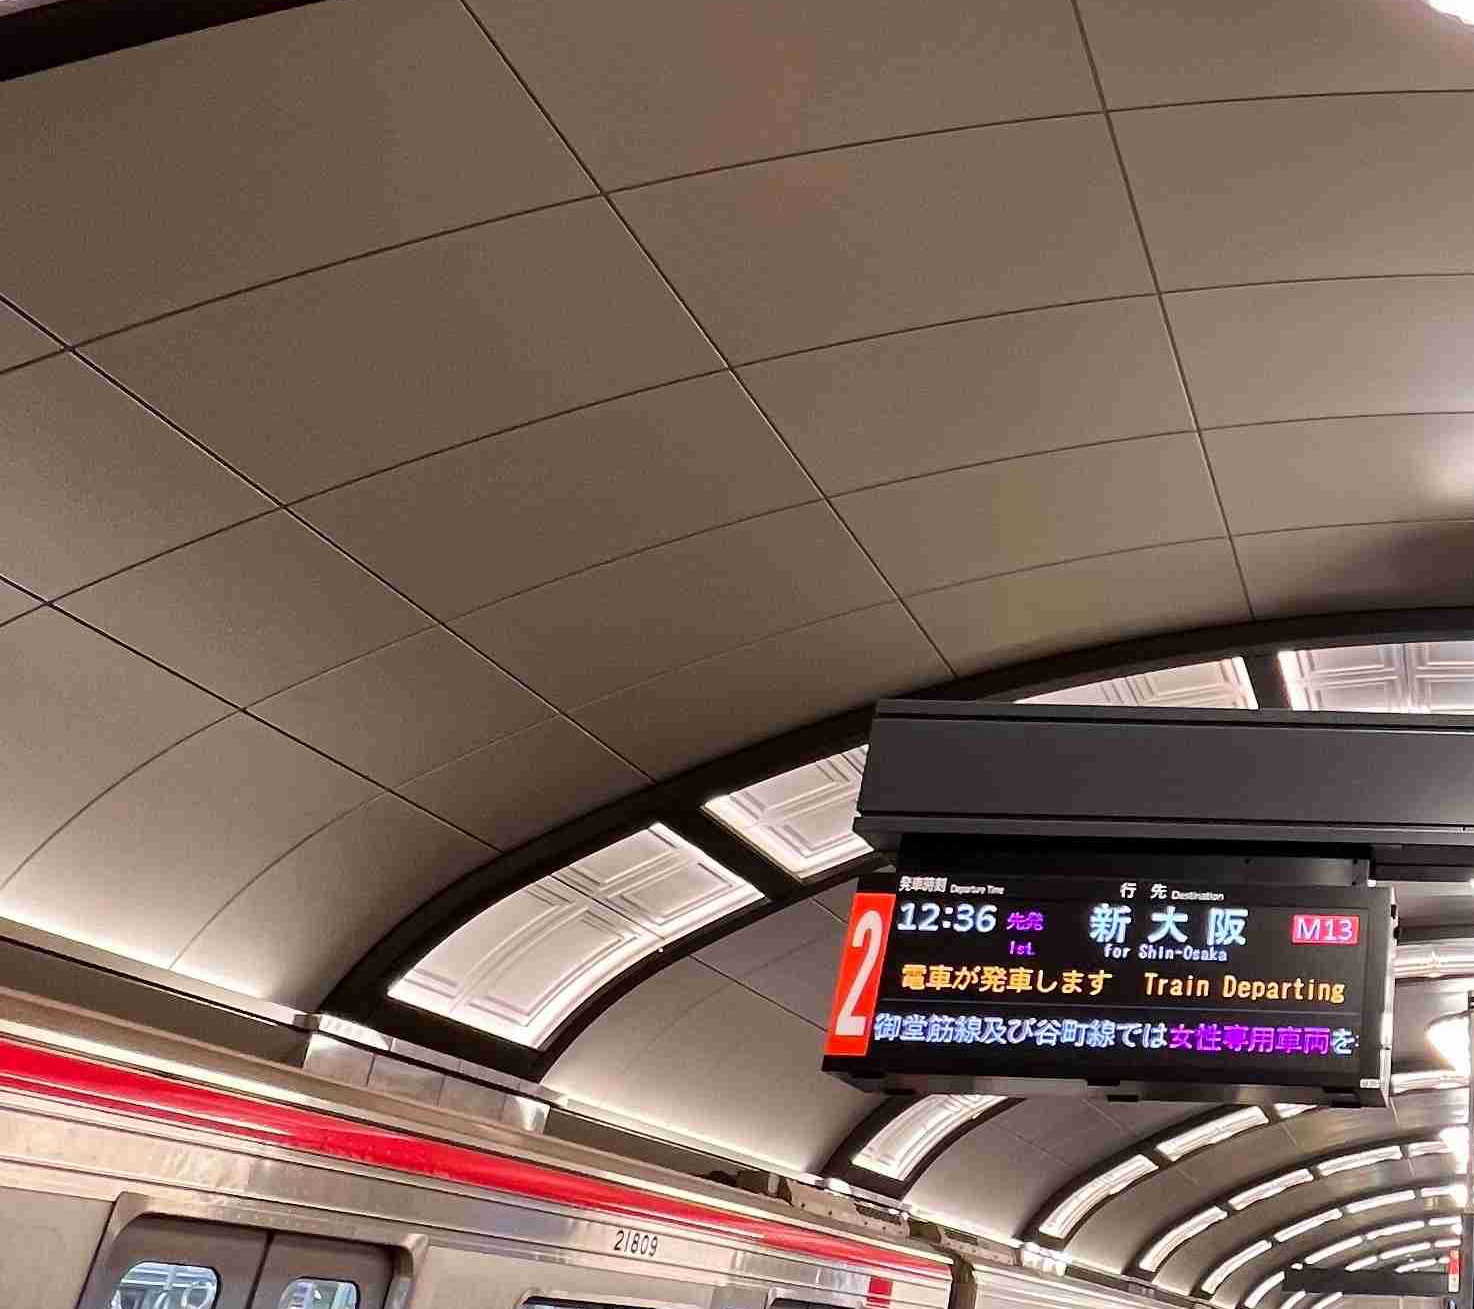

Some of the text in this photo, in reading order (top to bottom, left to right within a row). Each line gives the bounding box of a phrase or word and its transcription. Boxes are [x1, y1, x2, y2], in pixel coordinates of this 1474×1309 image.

[1171, 890, 1225, 902] Destination
[897, 902, 1044, 933] 12:36 先発
[1089, 903, 1250, 947] 新大阪
[1296, 918, 1354, 942] M13
[1104, 943, 1228, 963] for Shin-Osaka
[836, 909, 881, 1037] 2
[901, 963, 1113, 996] 電車が発車します
[1144, 971, 1346, 1004] Train Departing
[874, 1012, 1360, 1056] 御堂筋線及び谷町線では女性専用車両を
[613, 1230, 658, 1257] 21809
